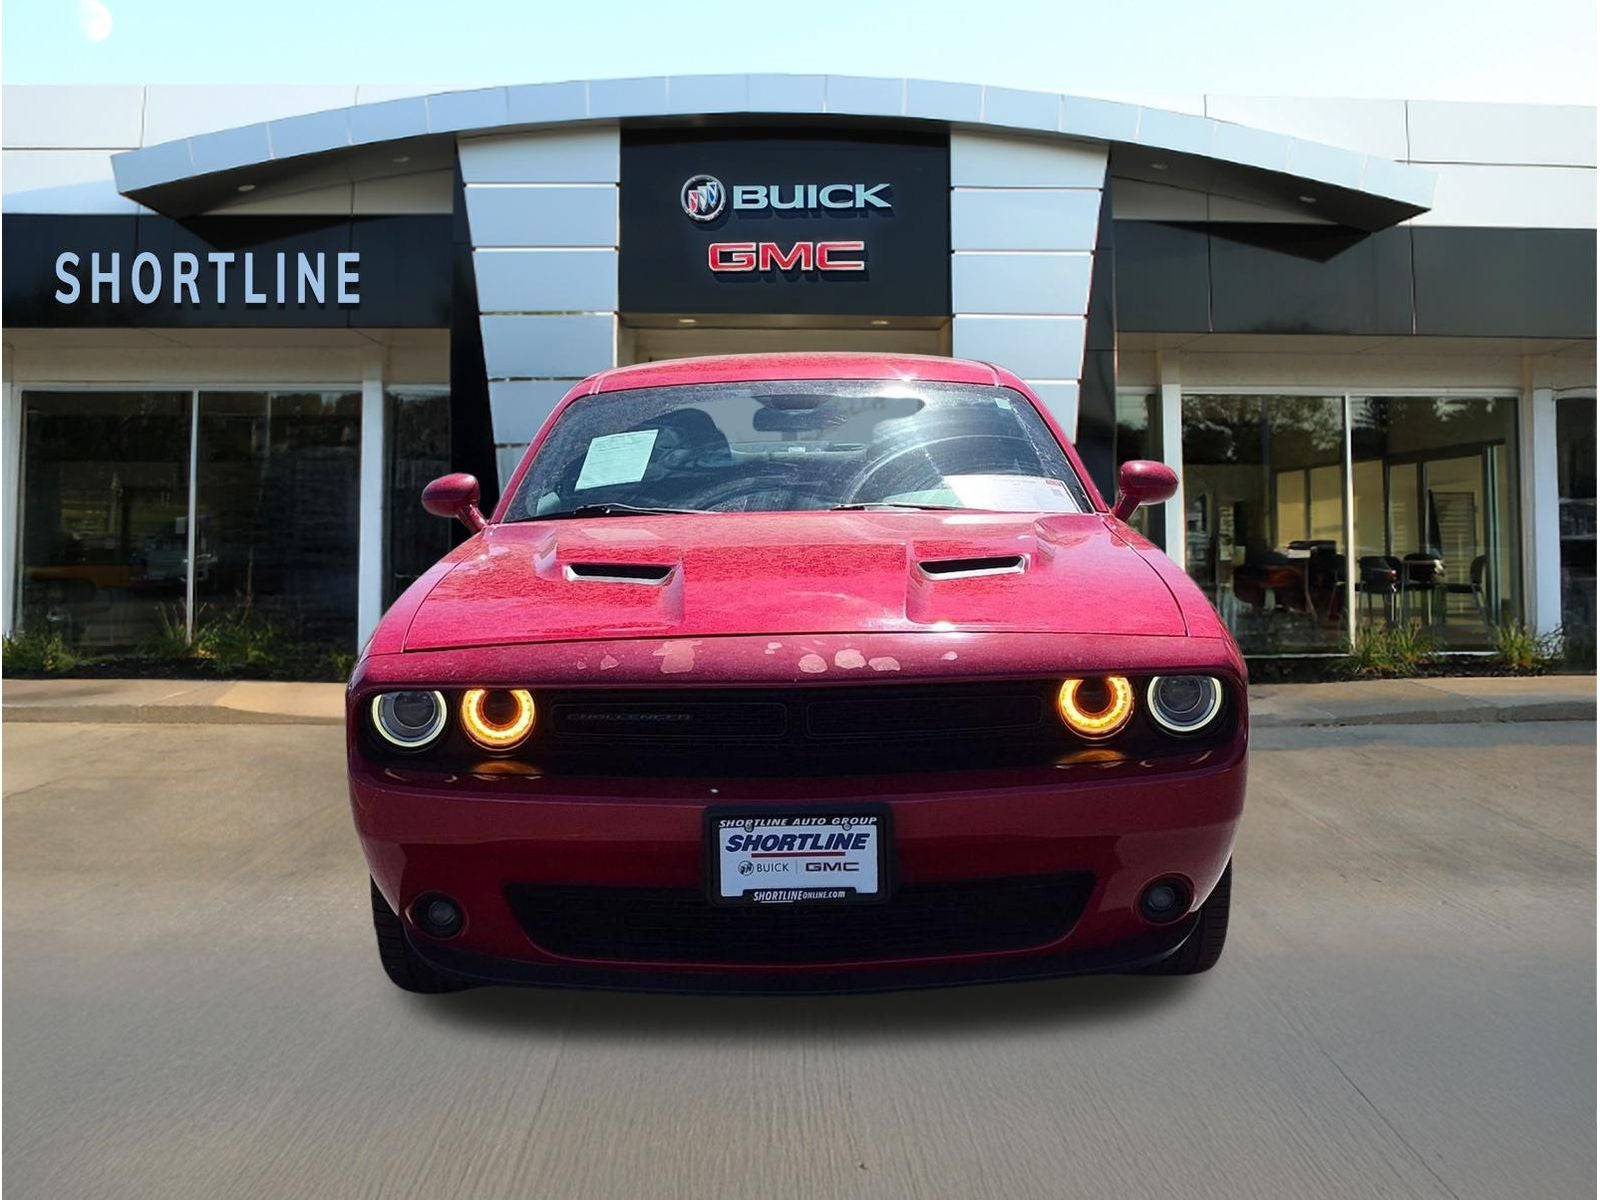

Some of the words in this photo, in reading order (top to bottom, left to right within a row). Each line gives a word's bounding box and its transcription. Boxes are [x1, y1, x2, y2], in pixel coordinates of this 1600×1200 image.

[733, 183, 892, 210] BUICK
[708, 240, 865, 272] GMC
[55, 251, 361, 304] SHORTLINE
[567, 713, 691, 721] CHALLENGER
[719, 818, 788, 828] SHORTLINE
[792, 817, 826, 826] AUTO
[831, 816, 878, 826] GROUP
[725, 832, 870, 852] SHORTLINE
[756, 863, 790, 873] BUICK
[805, 862, 860, 872] GMC
